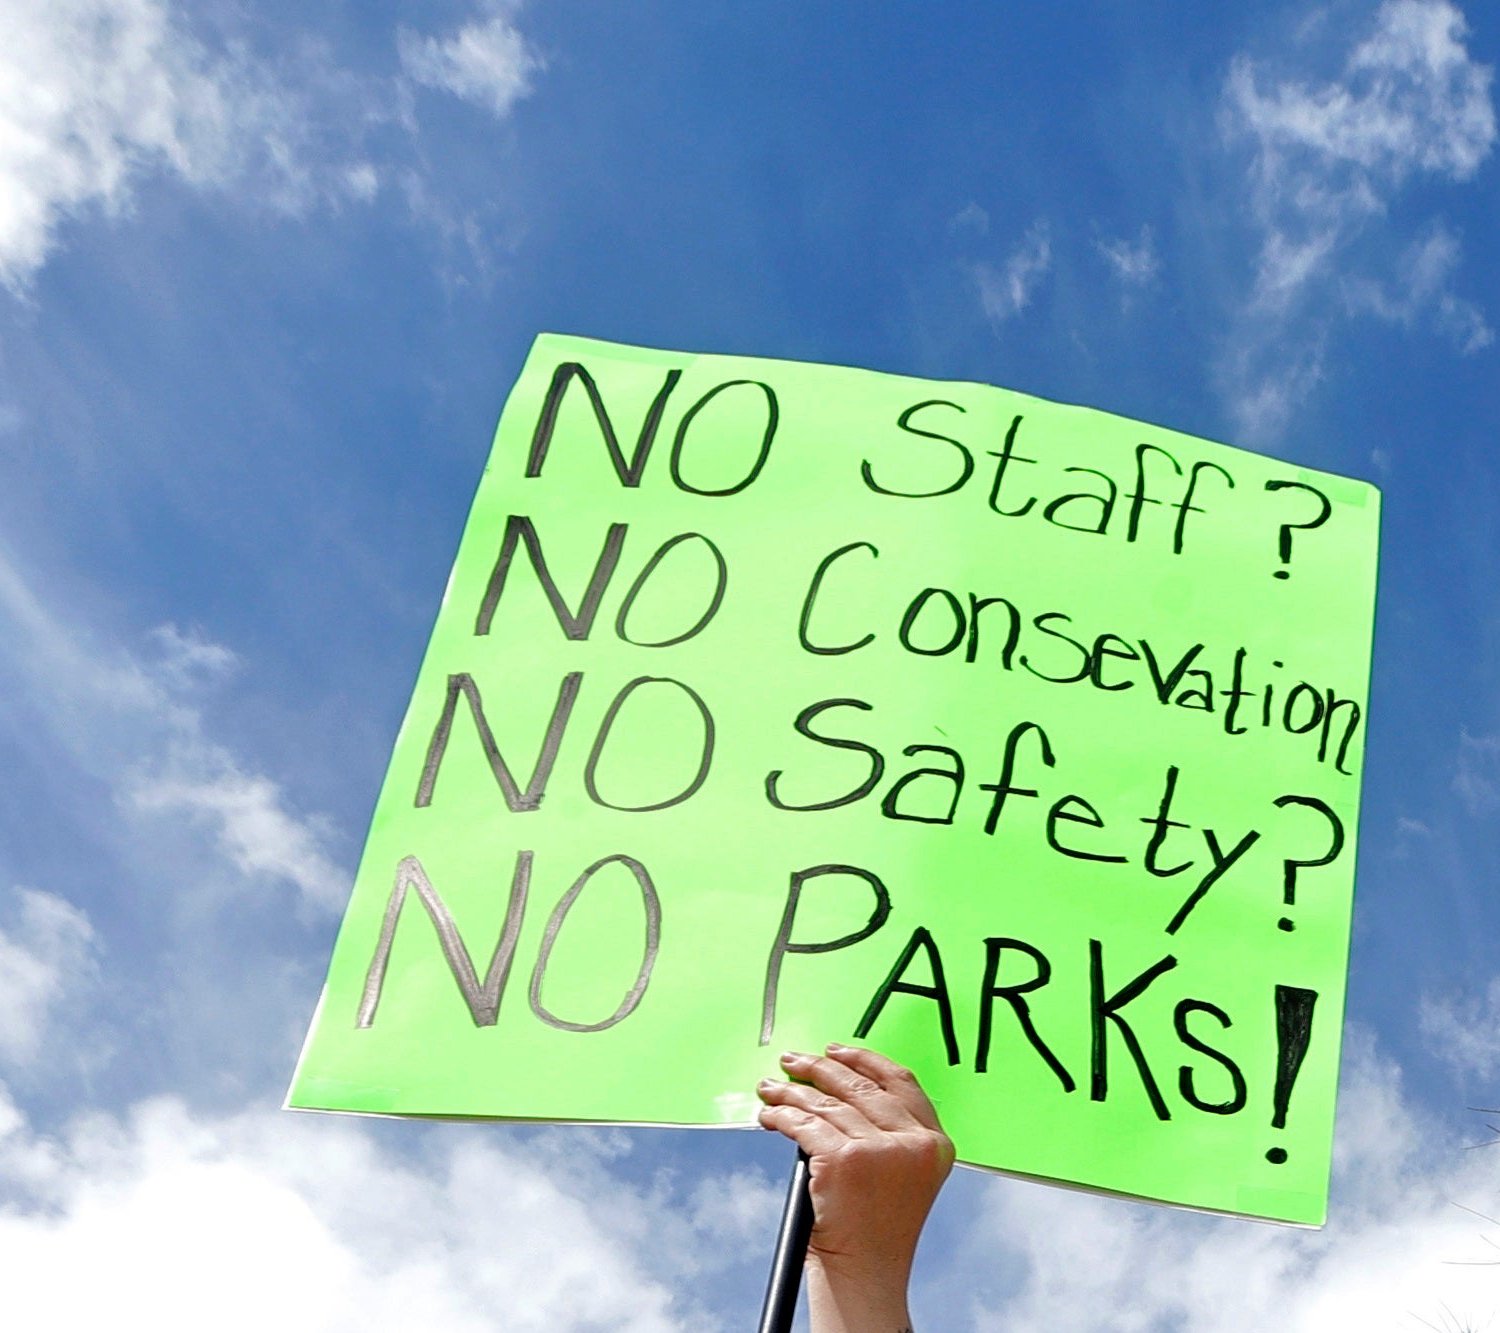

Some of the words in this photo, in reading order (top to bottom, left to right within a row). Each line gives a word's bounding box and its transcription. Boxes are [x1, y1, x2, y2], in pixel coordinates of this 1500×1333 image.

[526, 362, 779, 497] NO
[476, 514, 728, 648] NO
[797, 541, 1362, 777] Consevation
[414, 671, 716, 814] NO
[764, 697, 1346, 936] Safety?
[355, 850, 663, 1034] NO
[758, 864, 1319, 1165] PARKS!
